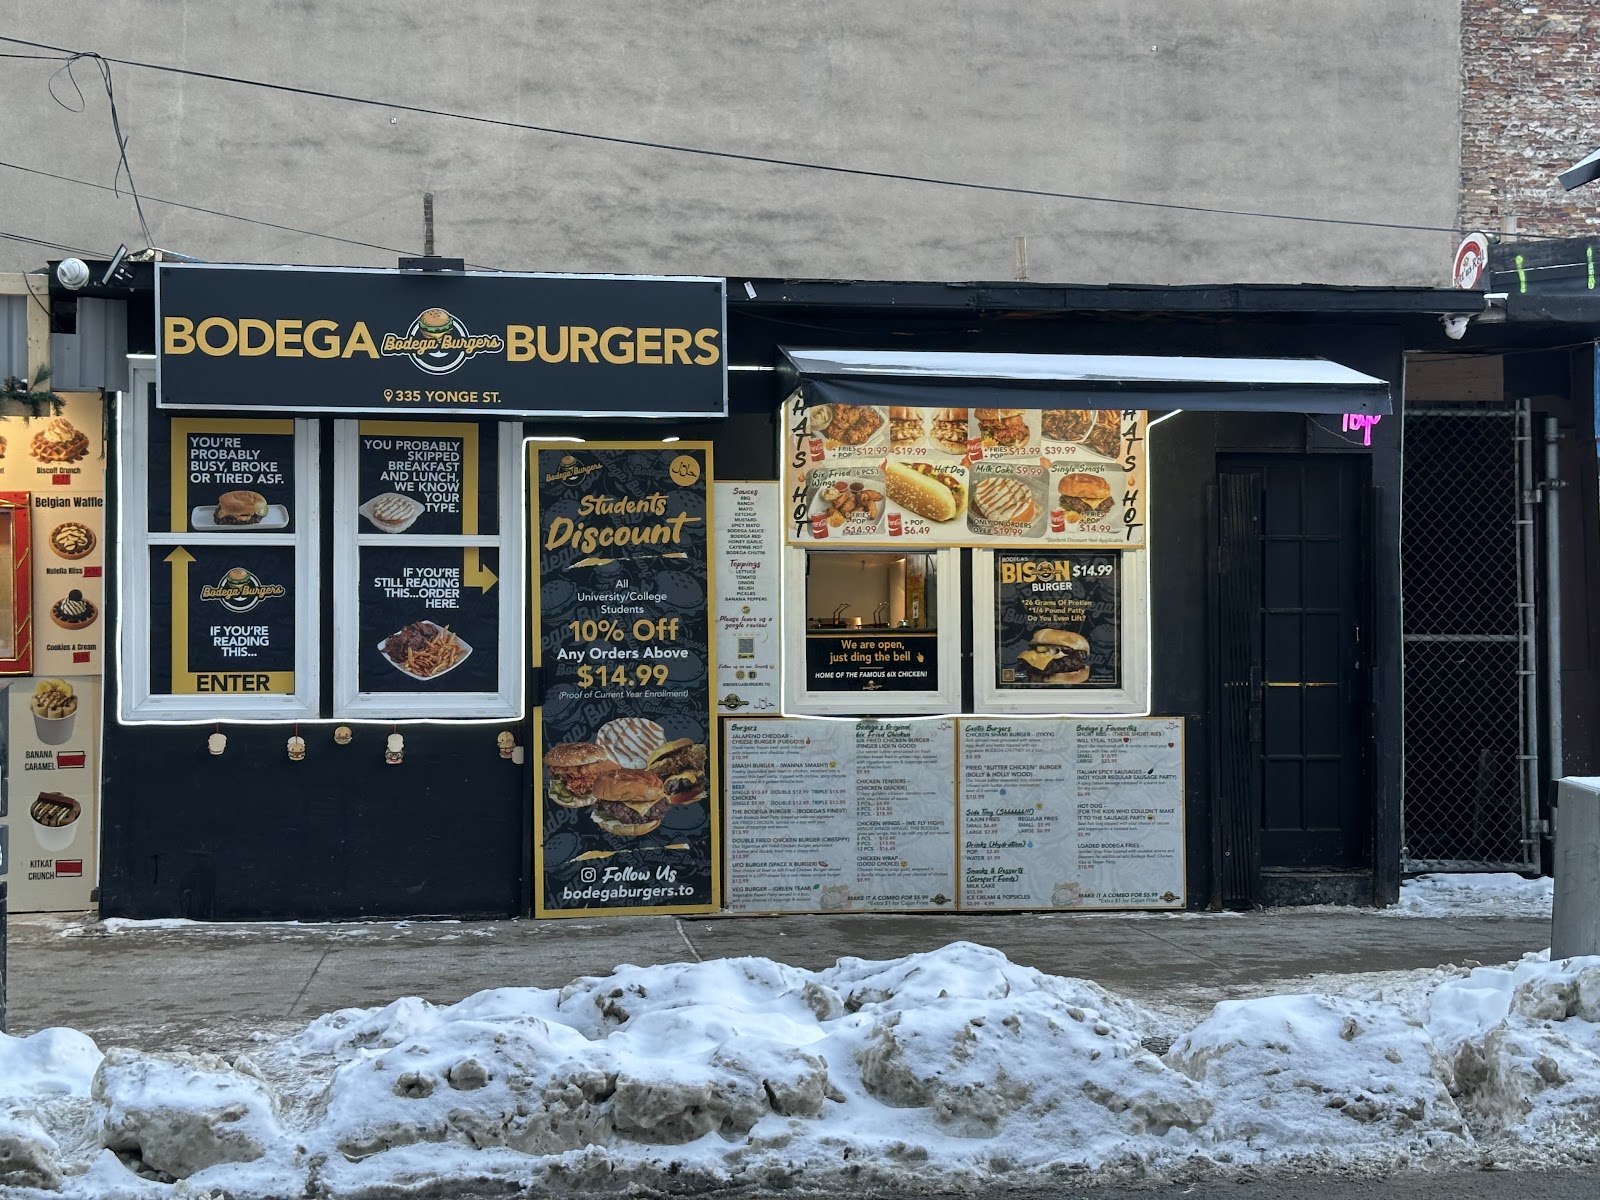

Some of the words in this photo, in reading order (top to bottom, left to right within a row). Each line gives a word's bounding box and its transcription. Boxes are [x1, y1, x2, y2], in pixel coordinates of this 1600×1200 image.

[165, 317, 380, 359] BODEGA
[384, 336, 438, 355] Bodega
[441, 335, 501, 354] Burgers
[507, 325, 720, 366] BURGERS
[396, 391, 420, 402] 335
[425, 391, 478, 402] YONGE
[483, 392, 501, 403] ST.
[190, 437, 241, 448] YOU'RE
[364, 440, 392, 450] YOU
[396, 441, 460, 451] PROBABLY
[191, 449, 260, 460] PROBABLY
[408, 451, 460, 461] SKIPPED
[857, 447, 888, 456] $12.99
[895, 447, 927, 456] $19.99
[1009, 447, 1040, 455] $13.99
[1045, 447, 1076, 455] $39.99
[191, 461, 227, 473] BUSY,
[232, 462, 278, 472] BROKE
[389, 461, 460, 472] BREAKFAST
[934, 465, 950, 474] Hot
[950, 466, 965, 476] Dog
[976, 465, 993, 473] Milk
[995, 465, 1014, 474] Cake
[1016, 466, 1042, 476] $9.99
[1051, 465, 1076, 475] Single
[1079, 465, 1105, 474] Smash
[380, 471, 409, 480] AND
[413, 472, 459, 483] LUNCH,
[546, 471, 572, 482] Bodega
[573, 463, 604, 476] Burgers
[828, 469, 851, 478] Fried
[190, 473, 210, 483] OR
[214, 473, 253, 484] TIRED
[257, 474, 284, 484] ASF.
[395, 482, 414, 491] WE
[419, 483, 460, 492] KNOW
[812, 480, 836, 489] Wings
[733, 488, 759, 496] Sauces
[35, 497, 71, 508] Belgian
[73, 497, 103, 507] Waffle
[424, 493, 459, 502] YOUR
[425, 503, 459, 513] TYPE.
[578, 492, 669, 516] Students
[792, 485, 813, 538] HOT
[1122, 490, 1144, 541] HOT
[545, 512, 702, 553] Discount
[845, 526, 877, 535] $14.99
[904, 527, 930, 535] $6.49
[993, 527, 1022, 536] $19.99
[1080, 525, 1111, 533] $14.99
[730, 559, 761, 569] Toppings
[404, 568, 413, 577] IF
[416, 568, 460, 578] YOU'RE
[1002, 560, 1070, 583] BISON
[1072, 565, 1113, 577] $14.99
[374, 578, 403, 588] STILL
[406, 579, 459, 588] READING
[616, 580, 629, 588] All
[1032, 582, 1073, 592] BURGER
[203, 587, 238, 599] Bodega
[242, 586, 283, 598] Burgers
[384, 588, 460, 598] THIS...ORDER
[577, 592, 667, 603] University/College
[426, 599, 459, 608] HERE.
[601, 605, 645, 614] Students
[1067, 607, 1085, 615] Patty
[210, 626, 221, 636] IF
[223, 626, 269, 636] YOU'RE
[569, 620, 625, 642] 10%
[632, 618, 679, 641] Off
[214, 637, 269, 646] READING
[841, 640, 858, 649] We
[860, 641, 876, 649] are
[878, 641, 905, 651] open,
[221, 647, 257, 657] THIS...
[557, 648, 586, 663] Any
[590, 647, 639, 660] Orders
[643, 646, 689, 659] Above
[829, 652, 848, 665] just
[851, 652, 872, 664] ding
[874, 652, 891, 661] the
[893, 651, 911, 661] bell
[577, 664, 669, 688] $14.99
[197, 675, 270, 692] ENTER
[559, 691, 584, 700] (Proof
[585, 691, 593, 699] of
[598, 691, 624, 699] Current
[645, 690, 689, 698] Enrollment)
[731, 724, 757, 732] Burgers
[26, 751, 53, 759] BANANA
[25, 763, 55, 771] CARAMEL
[966, 841, 987, 849] Drinks
[30, 860, 53, 868] KITKAT
[29, 872, 54, 880] CRUNCH
[602, 866, 651, 884] Follow
[656, 864, 678, 883] Us
[563, 885, 694, 901] bodegaburgers.to
